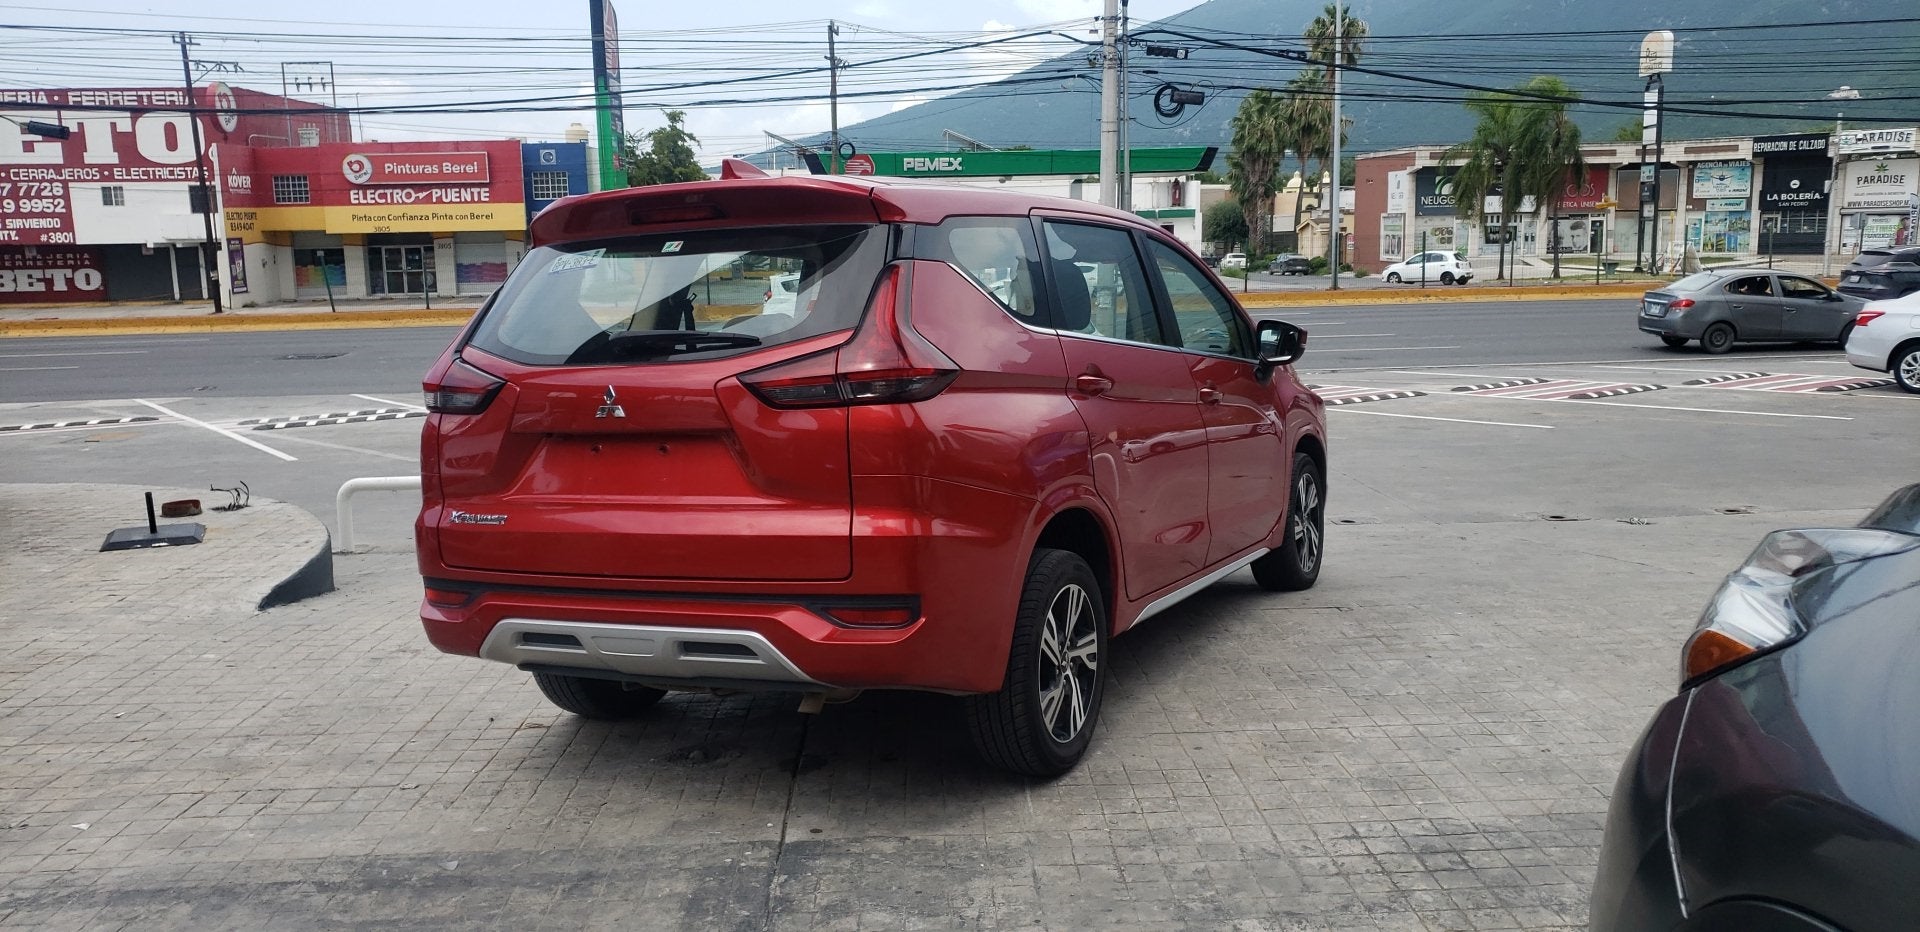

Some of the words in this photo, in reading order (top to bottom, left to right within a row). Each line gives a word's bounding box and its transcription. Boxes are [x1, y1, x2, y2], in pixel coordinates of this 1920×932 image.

[1753, 141, 1788, 153] REPARACION
[1789, 140, 1797, 151] DE
[1799, 139, 1826, 150] CALZADO
[384, 162, 439, 175] Pinturas
[442, 161, 478, 174] Berel
[903, 157, 962, 171] PEMEX
[1697, 161, 1723, 169] AGENCIA
[10, 168, 100, 180] CERRAJEROS
[1856, 174, 1906, 186] PARADISE
[350, 188, 416, 205] ELECTRO
[432, 187, 490, 203] PUENTE
[1767, 193, 1779, 201] LA
[1781, 190, 1821, 200] BOLERÍA
[19, 198, 66, 213] 9952
[351, 213, 373, 222] Pinta
[387, 212, 430, 221] Confianza
[431, 212, 453, 221] Pinta
[469, 212, 494, 220] Berel
[5, 218, 61, 229] SIRVIENDO
[40, 232, 74, 243] #3801
